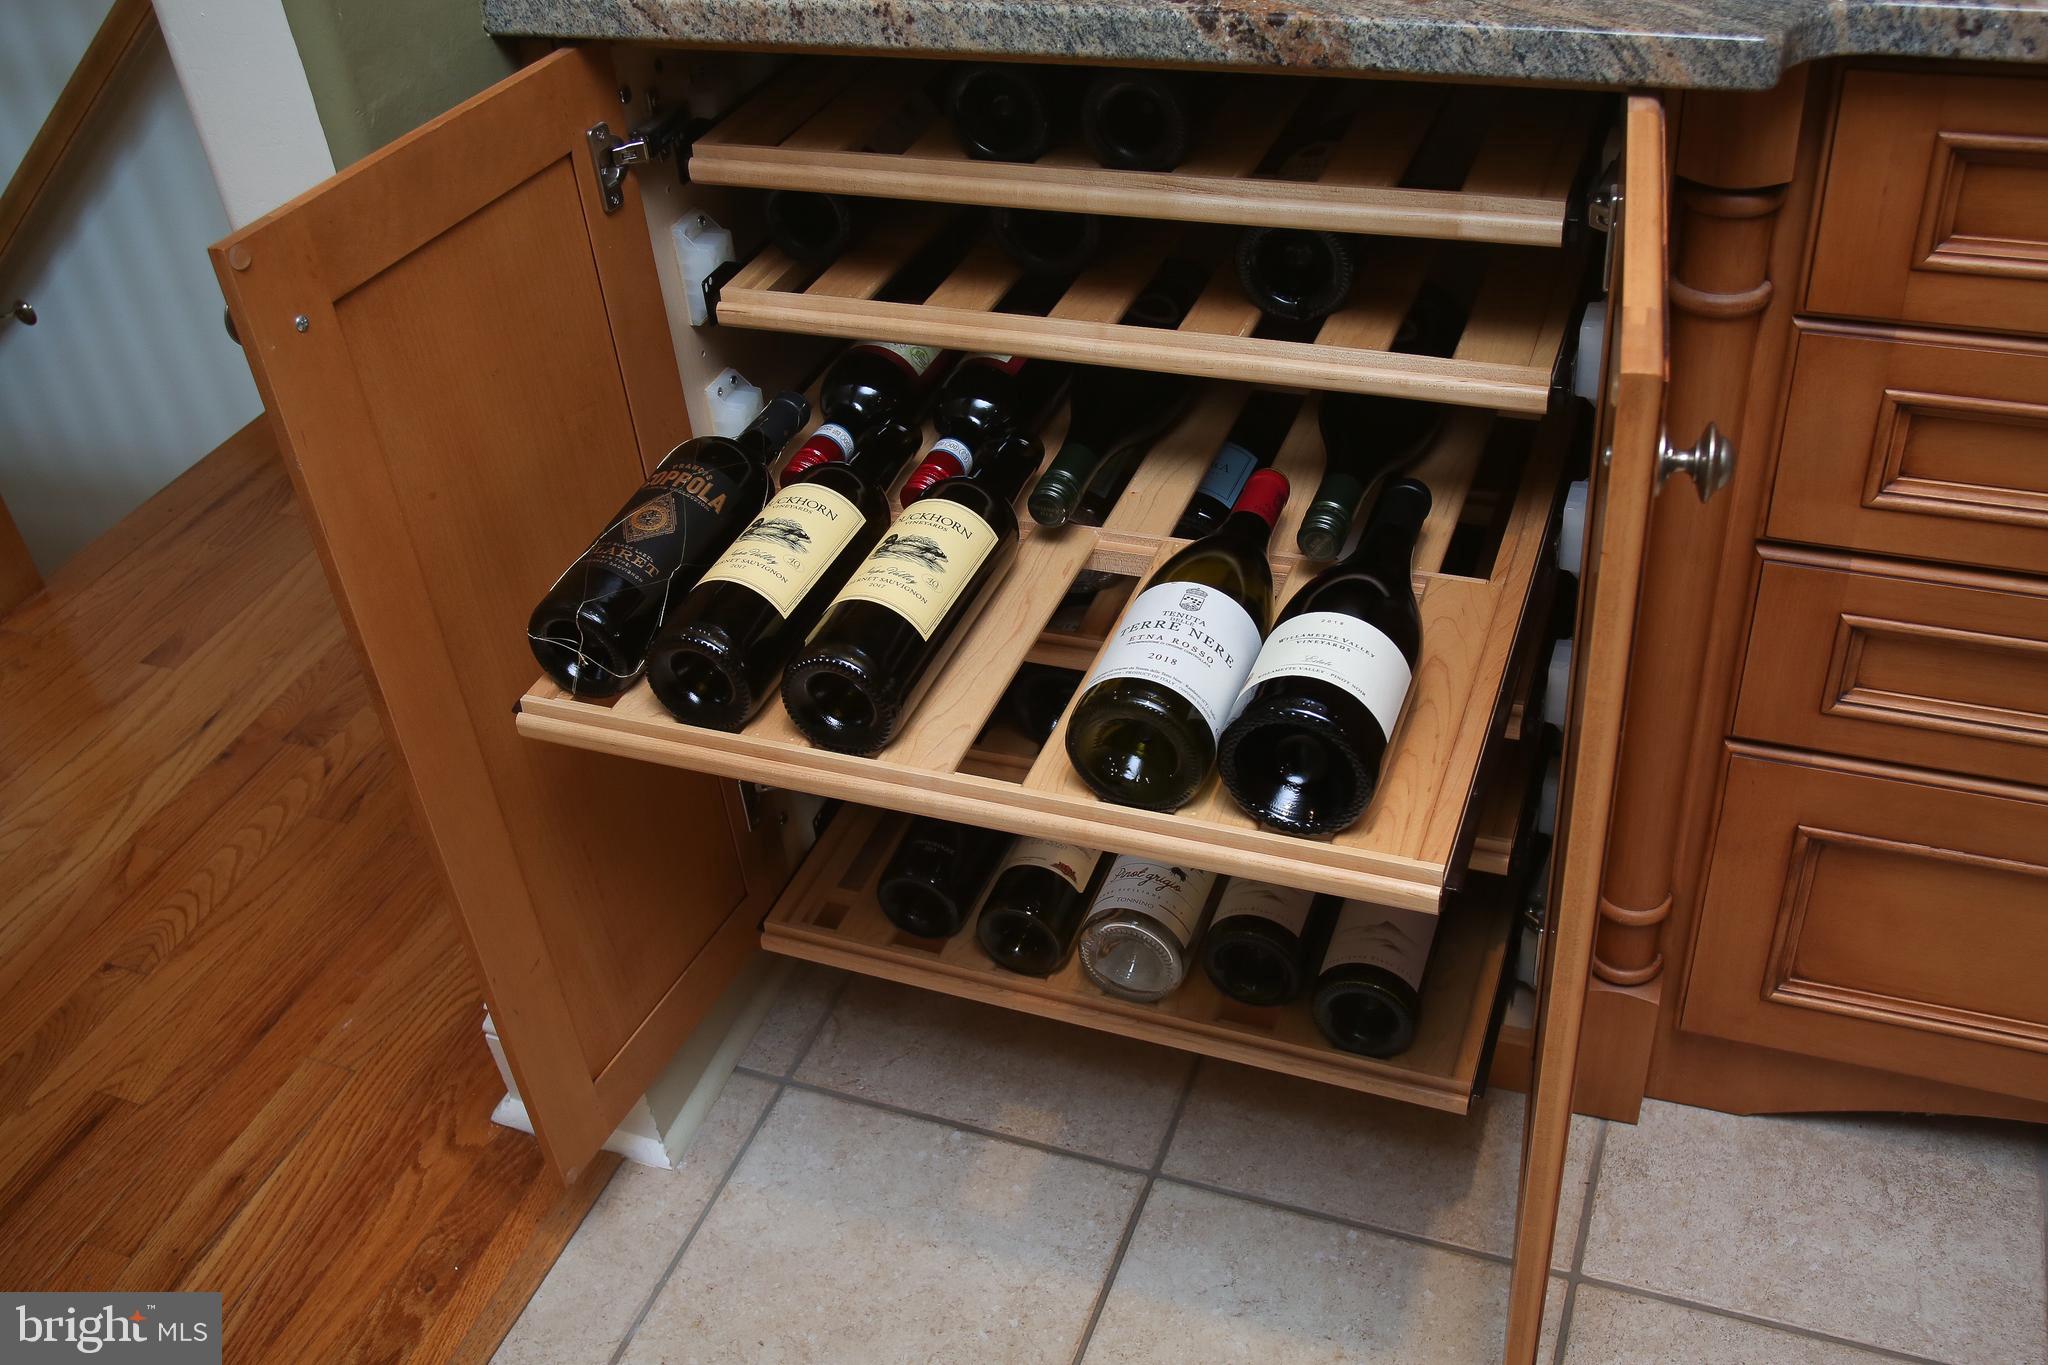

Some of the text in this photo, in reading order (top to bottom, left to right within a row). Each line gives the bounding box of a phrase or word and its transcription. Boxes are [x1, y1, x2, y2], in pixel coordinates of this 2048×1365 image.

[772, 502, 812, 514] VINEYARDS
[905, 520, 948, 532] VINEYARDS
[740, 558, 789, 584] SAUVIGNON
[878, 577, 928, 604] SAUVIGNON
[1162, 610, 1206, 628] TENUTA
[1169, 617, 1195, 627] DELLE
[1120, 619, 1234, 669] TERRE NERE
[1128, 634, 1215, 664] ETNA ROSSO
[1278, 633, 1376, 659] WILLAMETTE VALLEY
[1296, 639, 1352, 653] VINEYARDS
[1147, 652, 1178, 666] 2018
[1114, 867, 1182, 893] Pinot grigio
